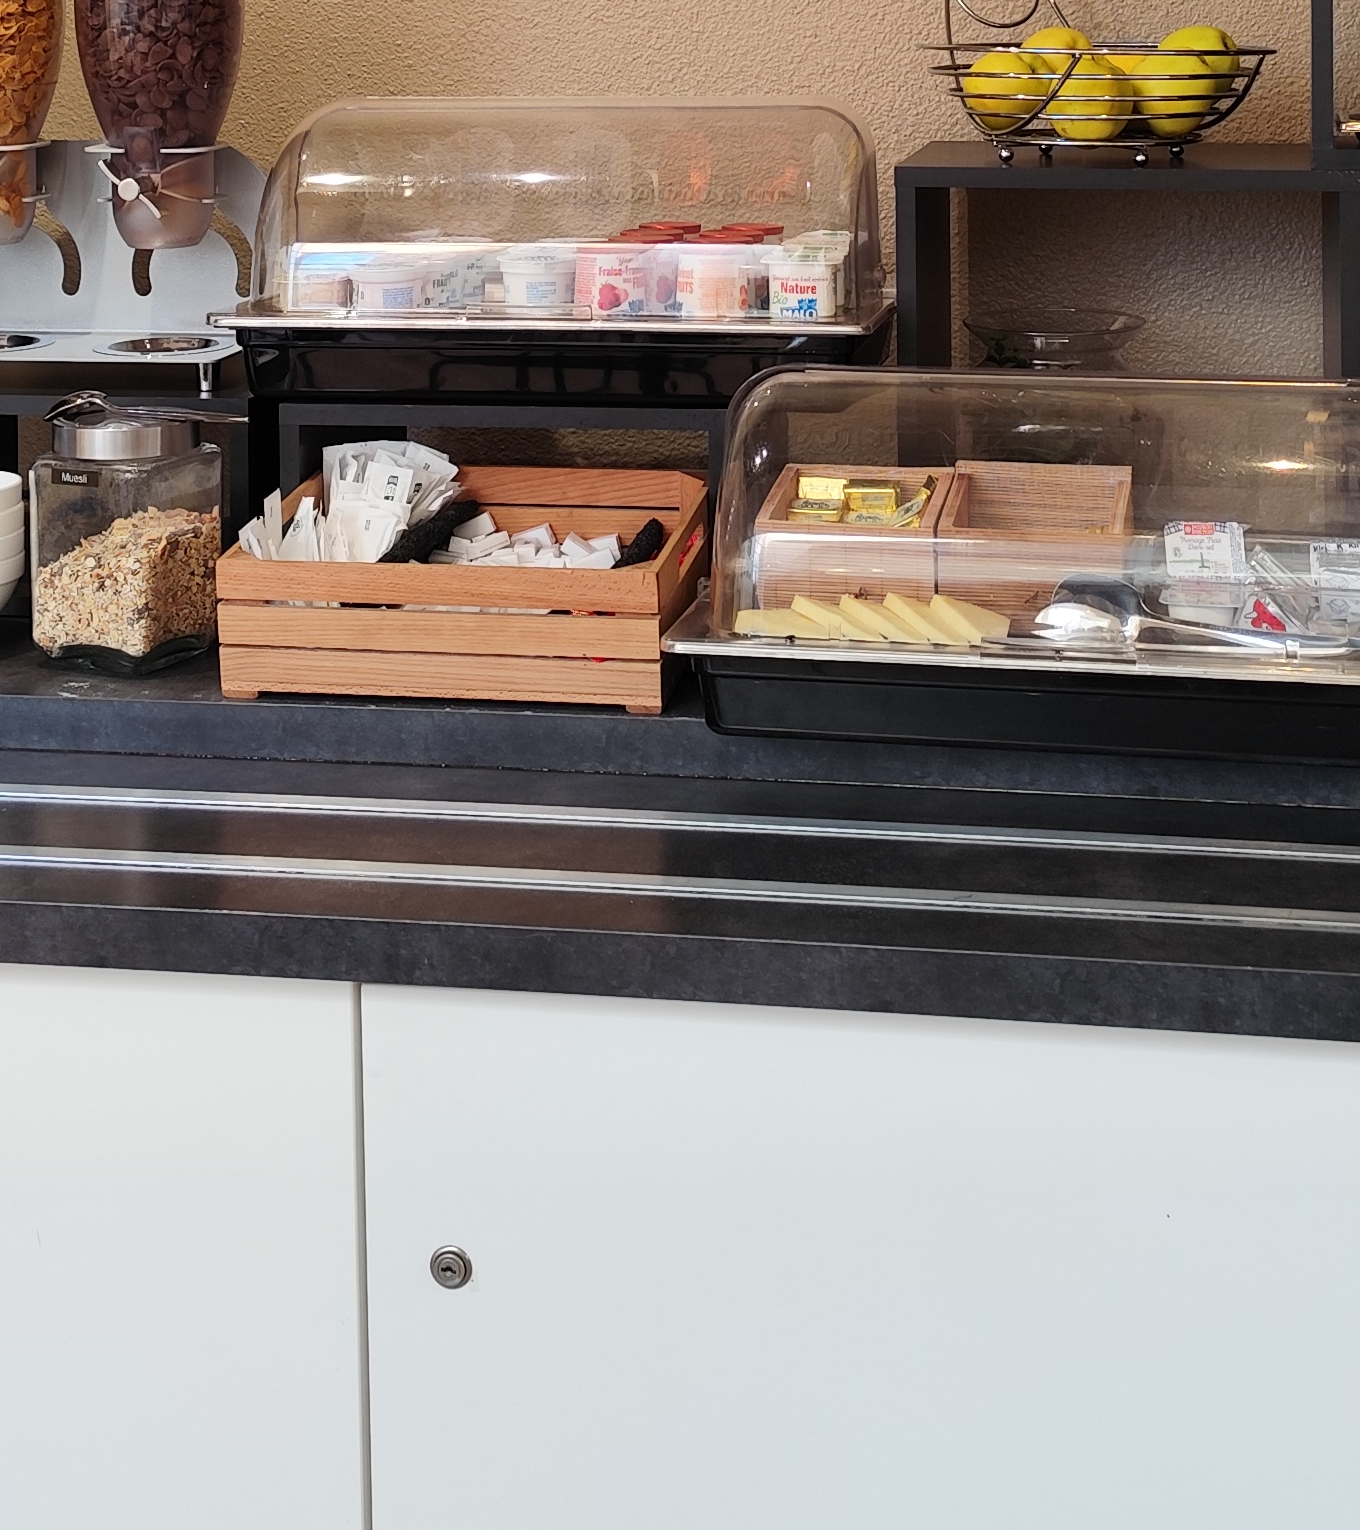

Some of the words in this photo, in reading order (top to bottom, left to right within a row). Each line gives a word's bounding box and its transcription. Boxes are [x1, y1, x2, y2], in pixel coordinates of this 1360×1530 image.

[781, 282, 817, 294] Nature
[772, 291, 788, 305] Bio
[782, 308, 817, 319] MALO
[61, 472, 87, 483] Muesli
